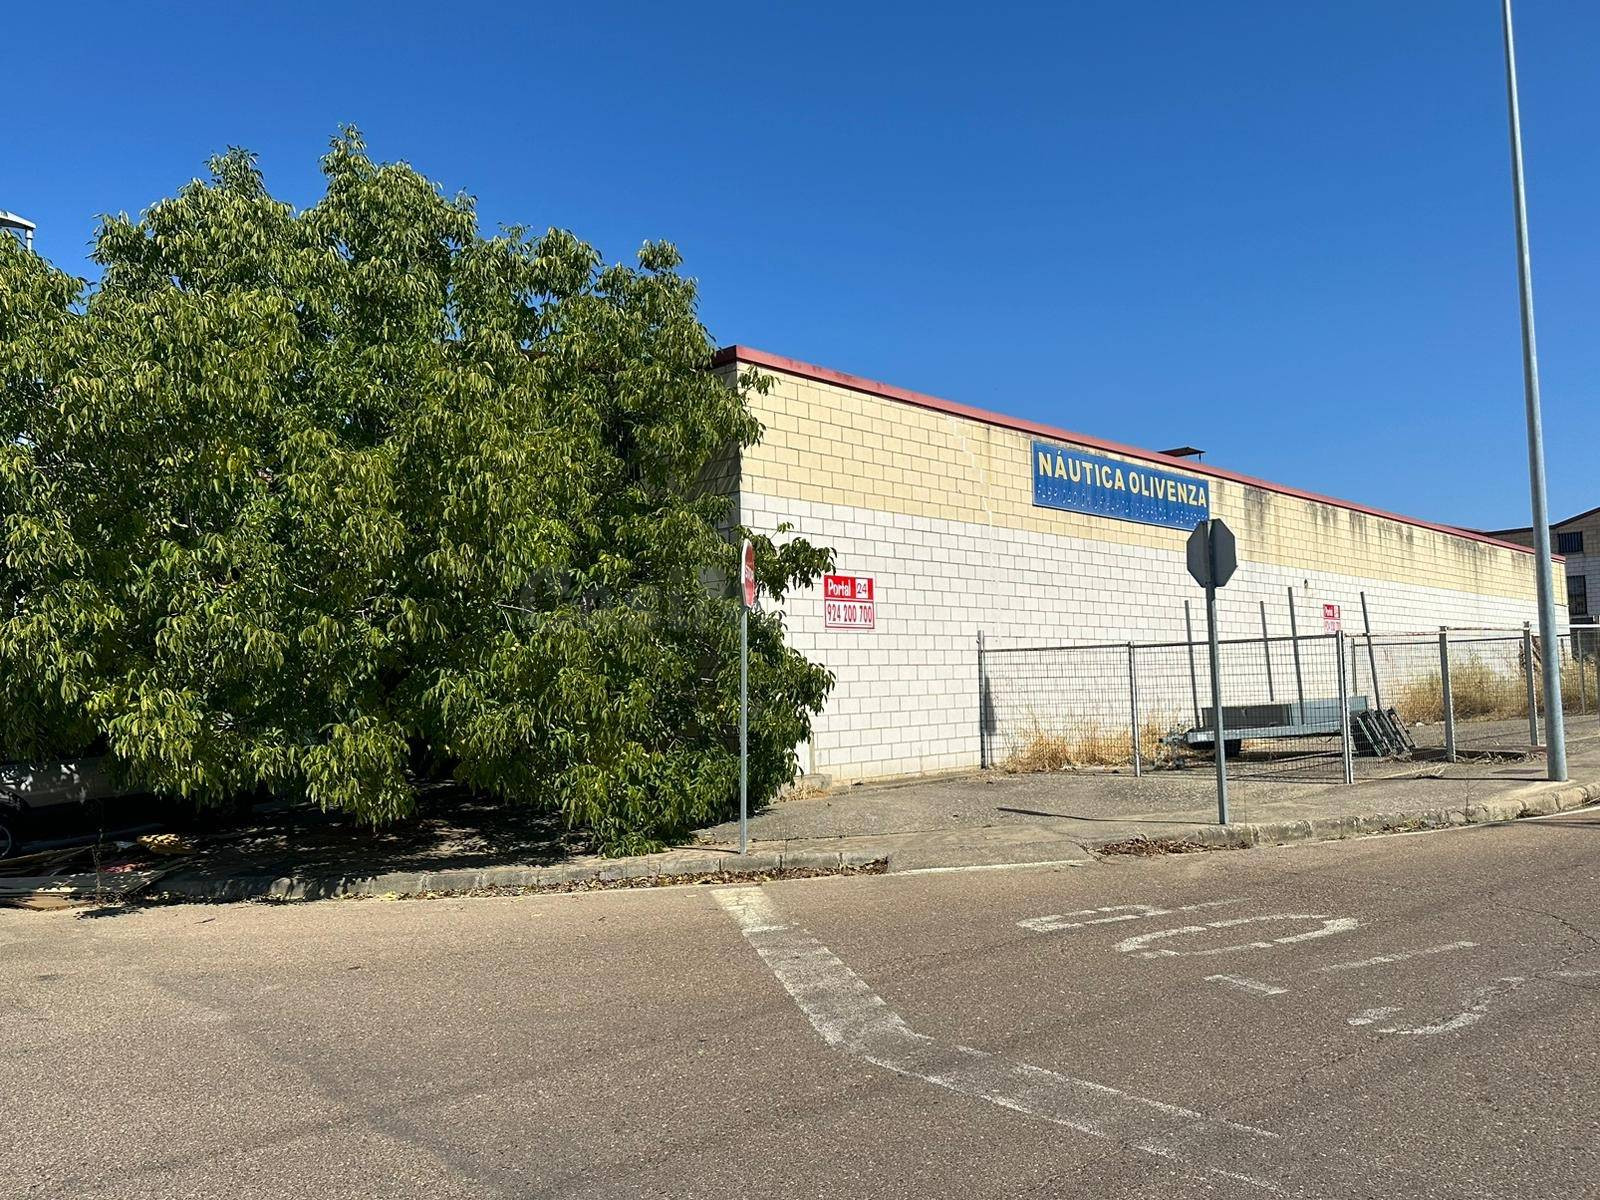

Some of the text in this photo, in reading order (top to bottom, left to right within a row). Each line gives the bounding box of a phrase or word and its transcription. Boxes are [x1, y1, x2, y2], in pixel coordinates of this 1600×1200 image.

[1038, 450, 1207, 508] NÁUTICA OLIVENZA
[828, 579, 867, 597] Portal 24
[827, 603, 872, 623] 924 200 700
